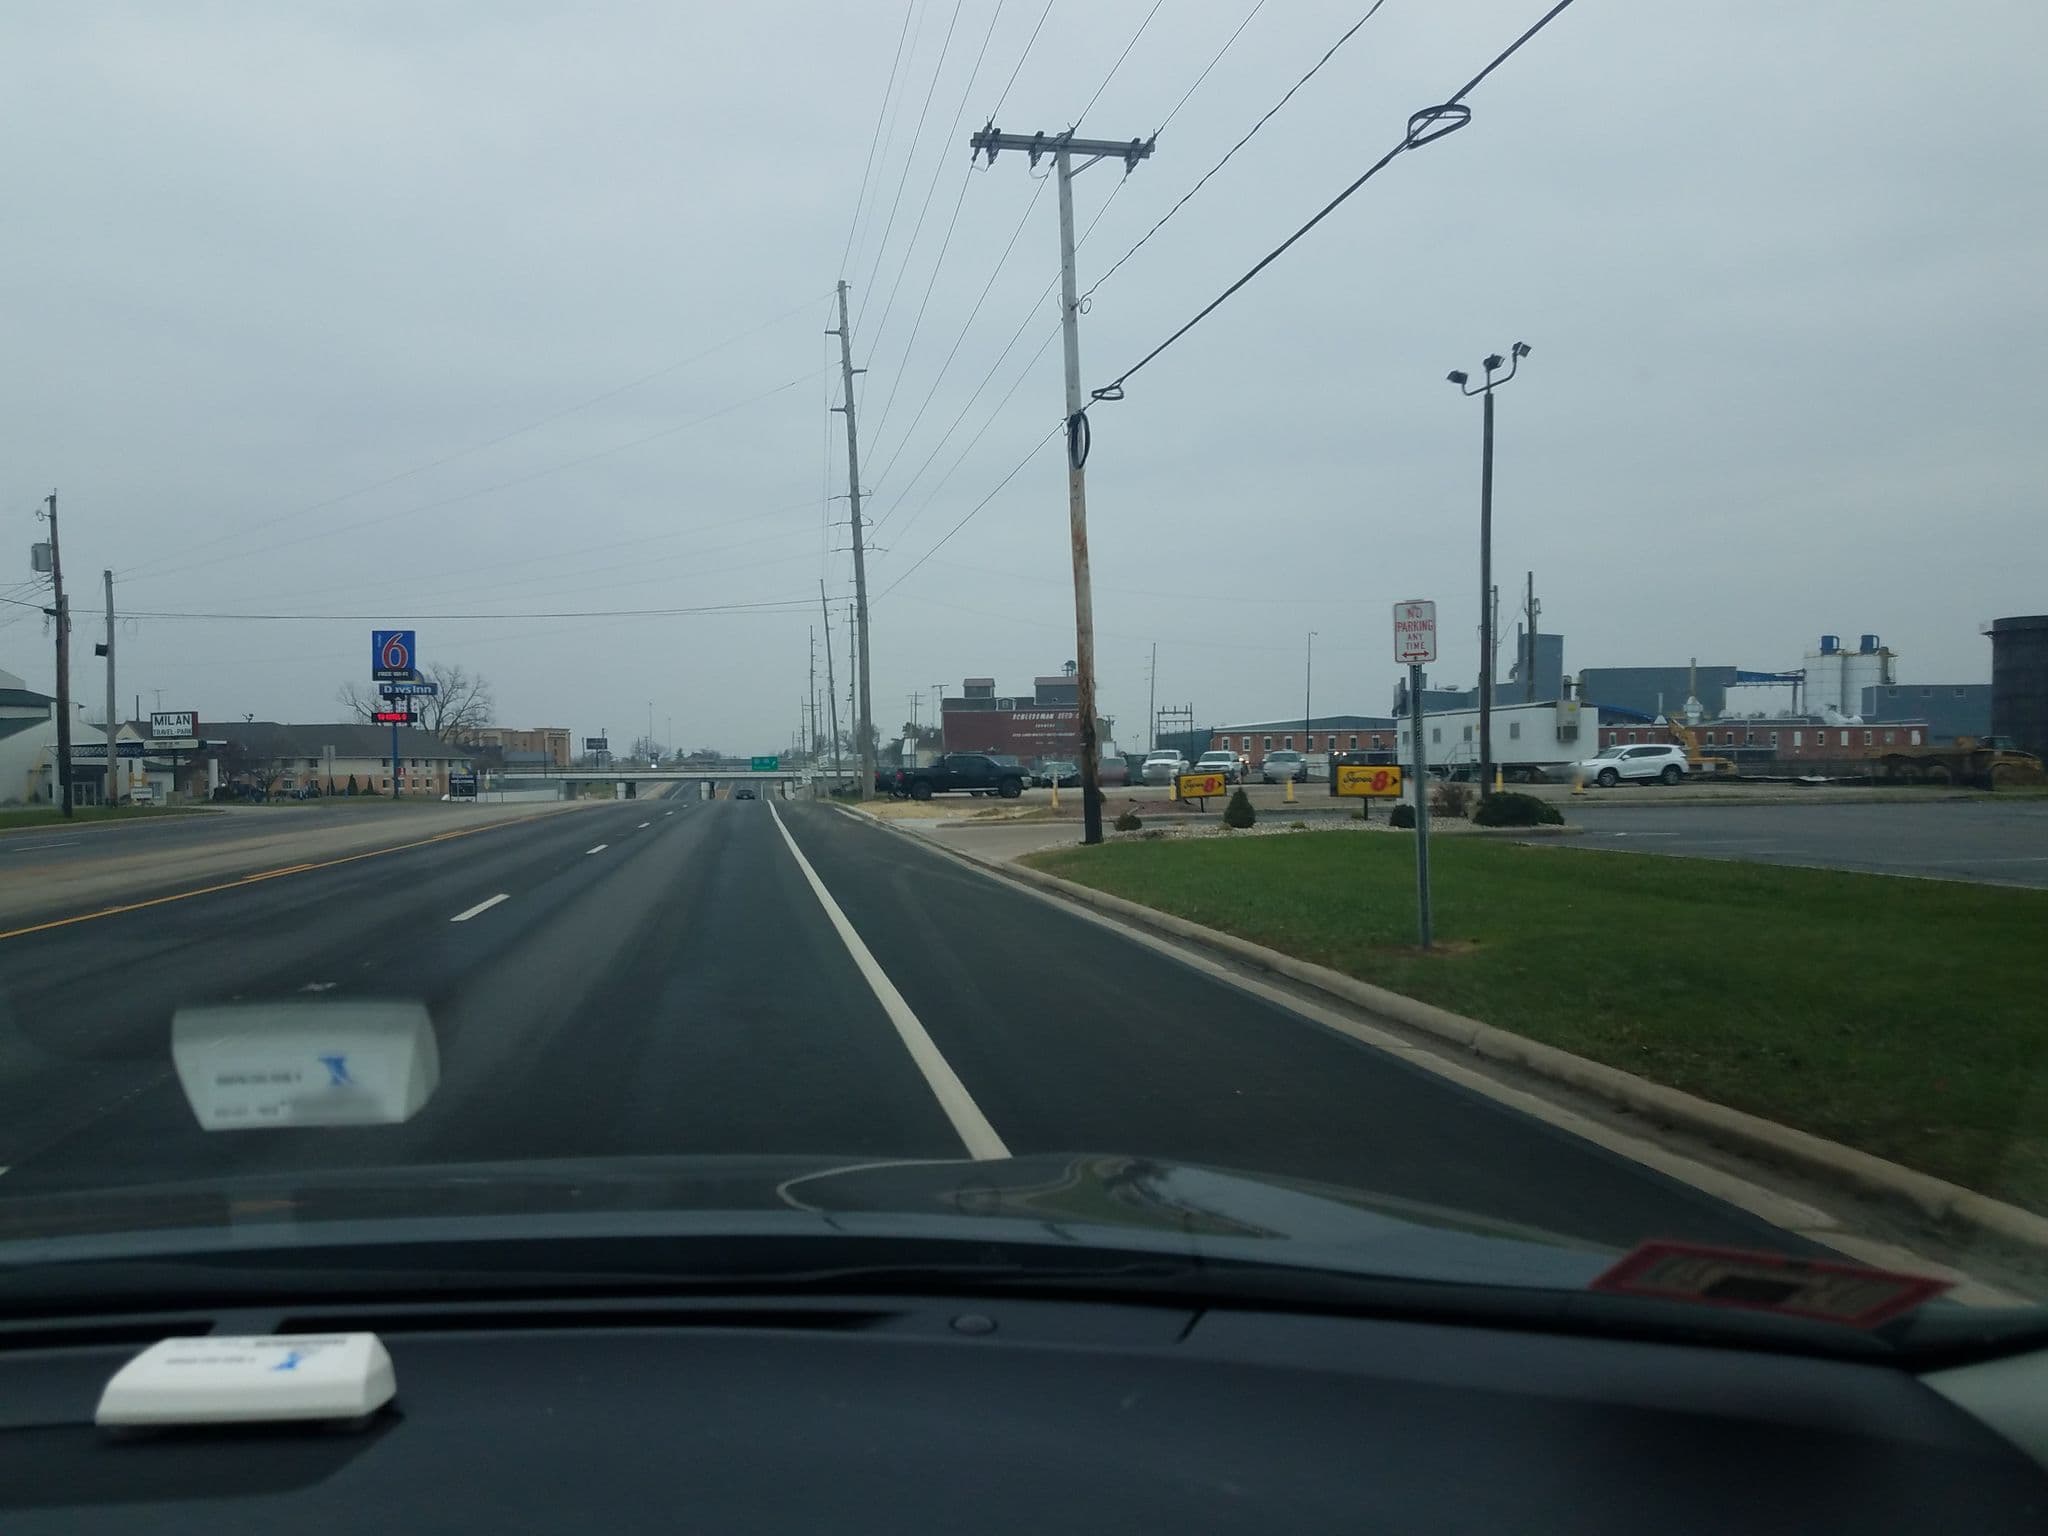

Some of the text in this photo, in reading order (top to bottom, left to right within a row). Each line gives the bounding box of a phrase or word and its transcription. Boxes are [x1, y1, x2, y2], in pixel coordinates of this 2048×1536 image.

[1407, 607, 1423, 618] NO
[1396, 620, 1434, 632] PARKING
[1407, 633, 1423, 641] ANY
[382, 632, 408, 669] 6
[1406, 641, 1425, 650] TIME
[413, 684, 431, 694] Inn
[154, 714, 191, 726] MILAN
[1203, 777, 1215, 792] 8
[1343, 770, 1389, 791] Super 8
